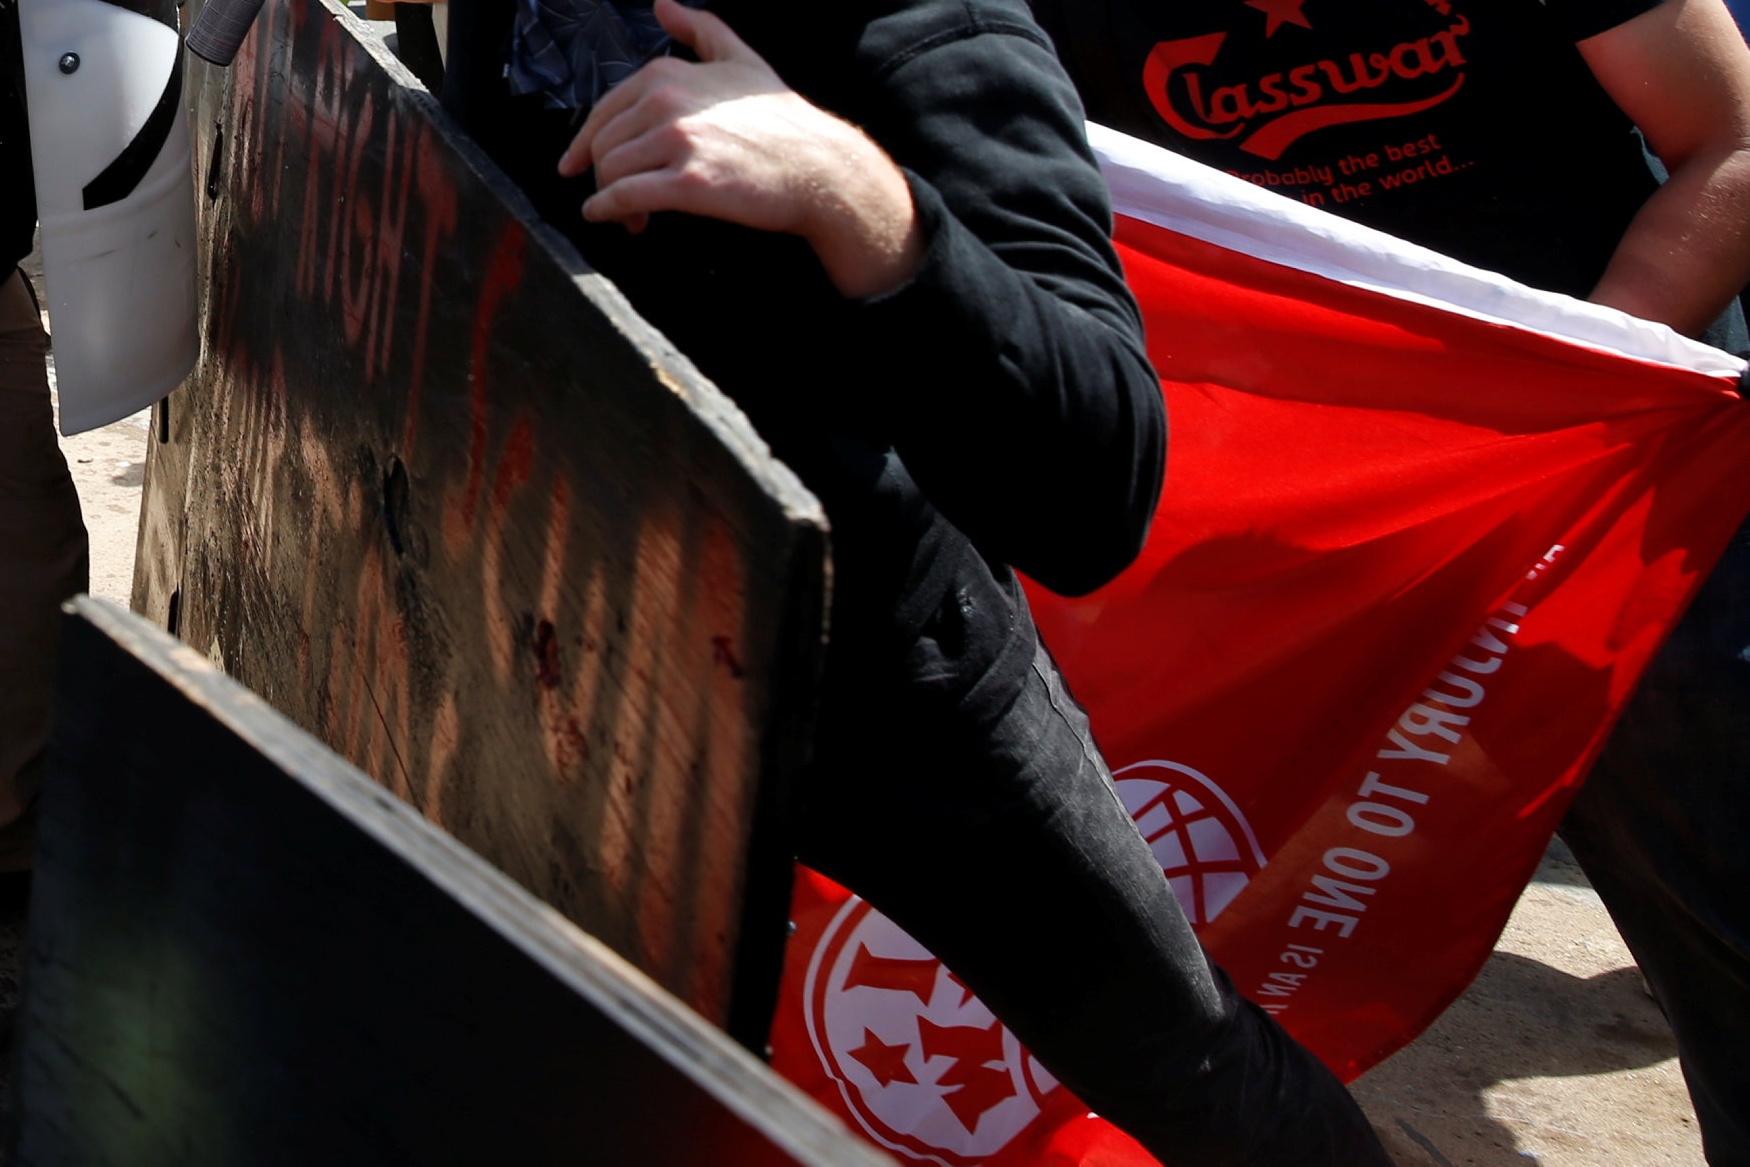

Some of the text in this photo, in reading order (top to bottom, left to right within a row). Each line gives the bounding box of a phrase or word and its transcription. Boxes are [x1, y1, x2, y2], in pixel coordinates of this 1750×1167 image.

[1142, 13, 1471, 140] Classwar
[1301, 154, 1475, 207] in the world...
[1337, 154, 1380, 176] the
[1383, 134, 1442, 163] best
